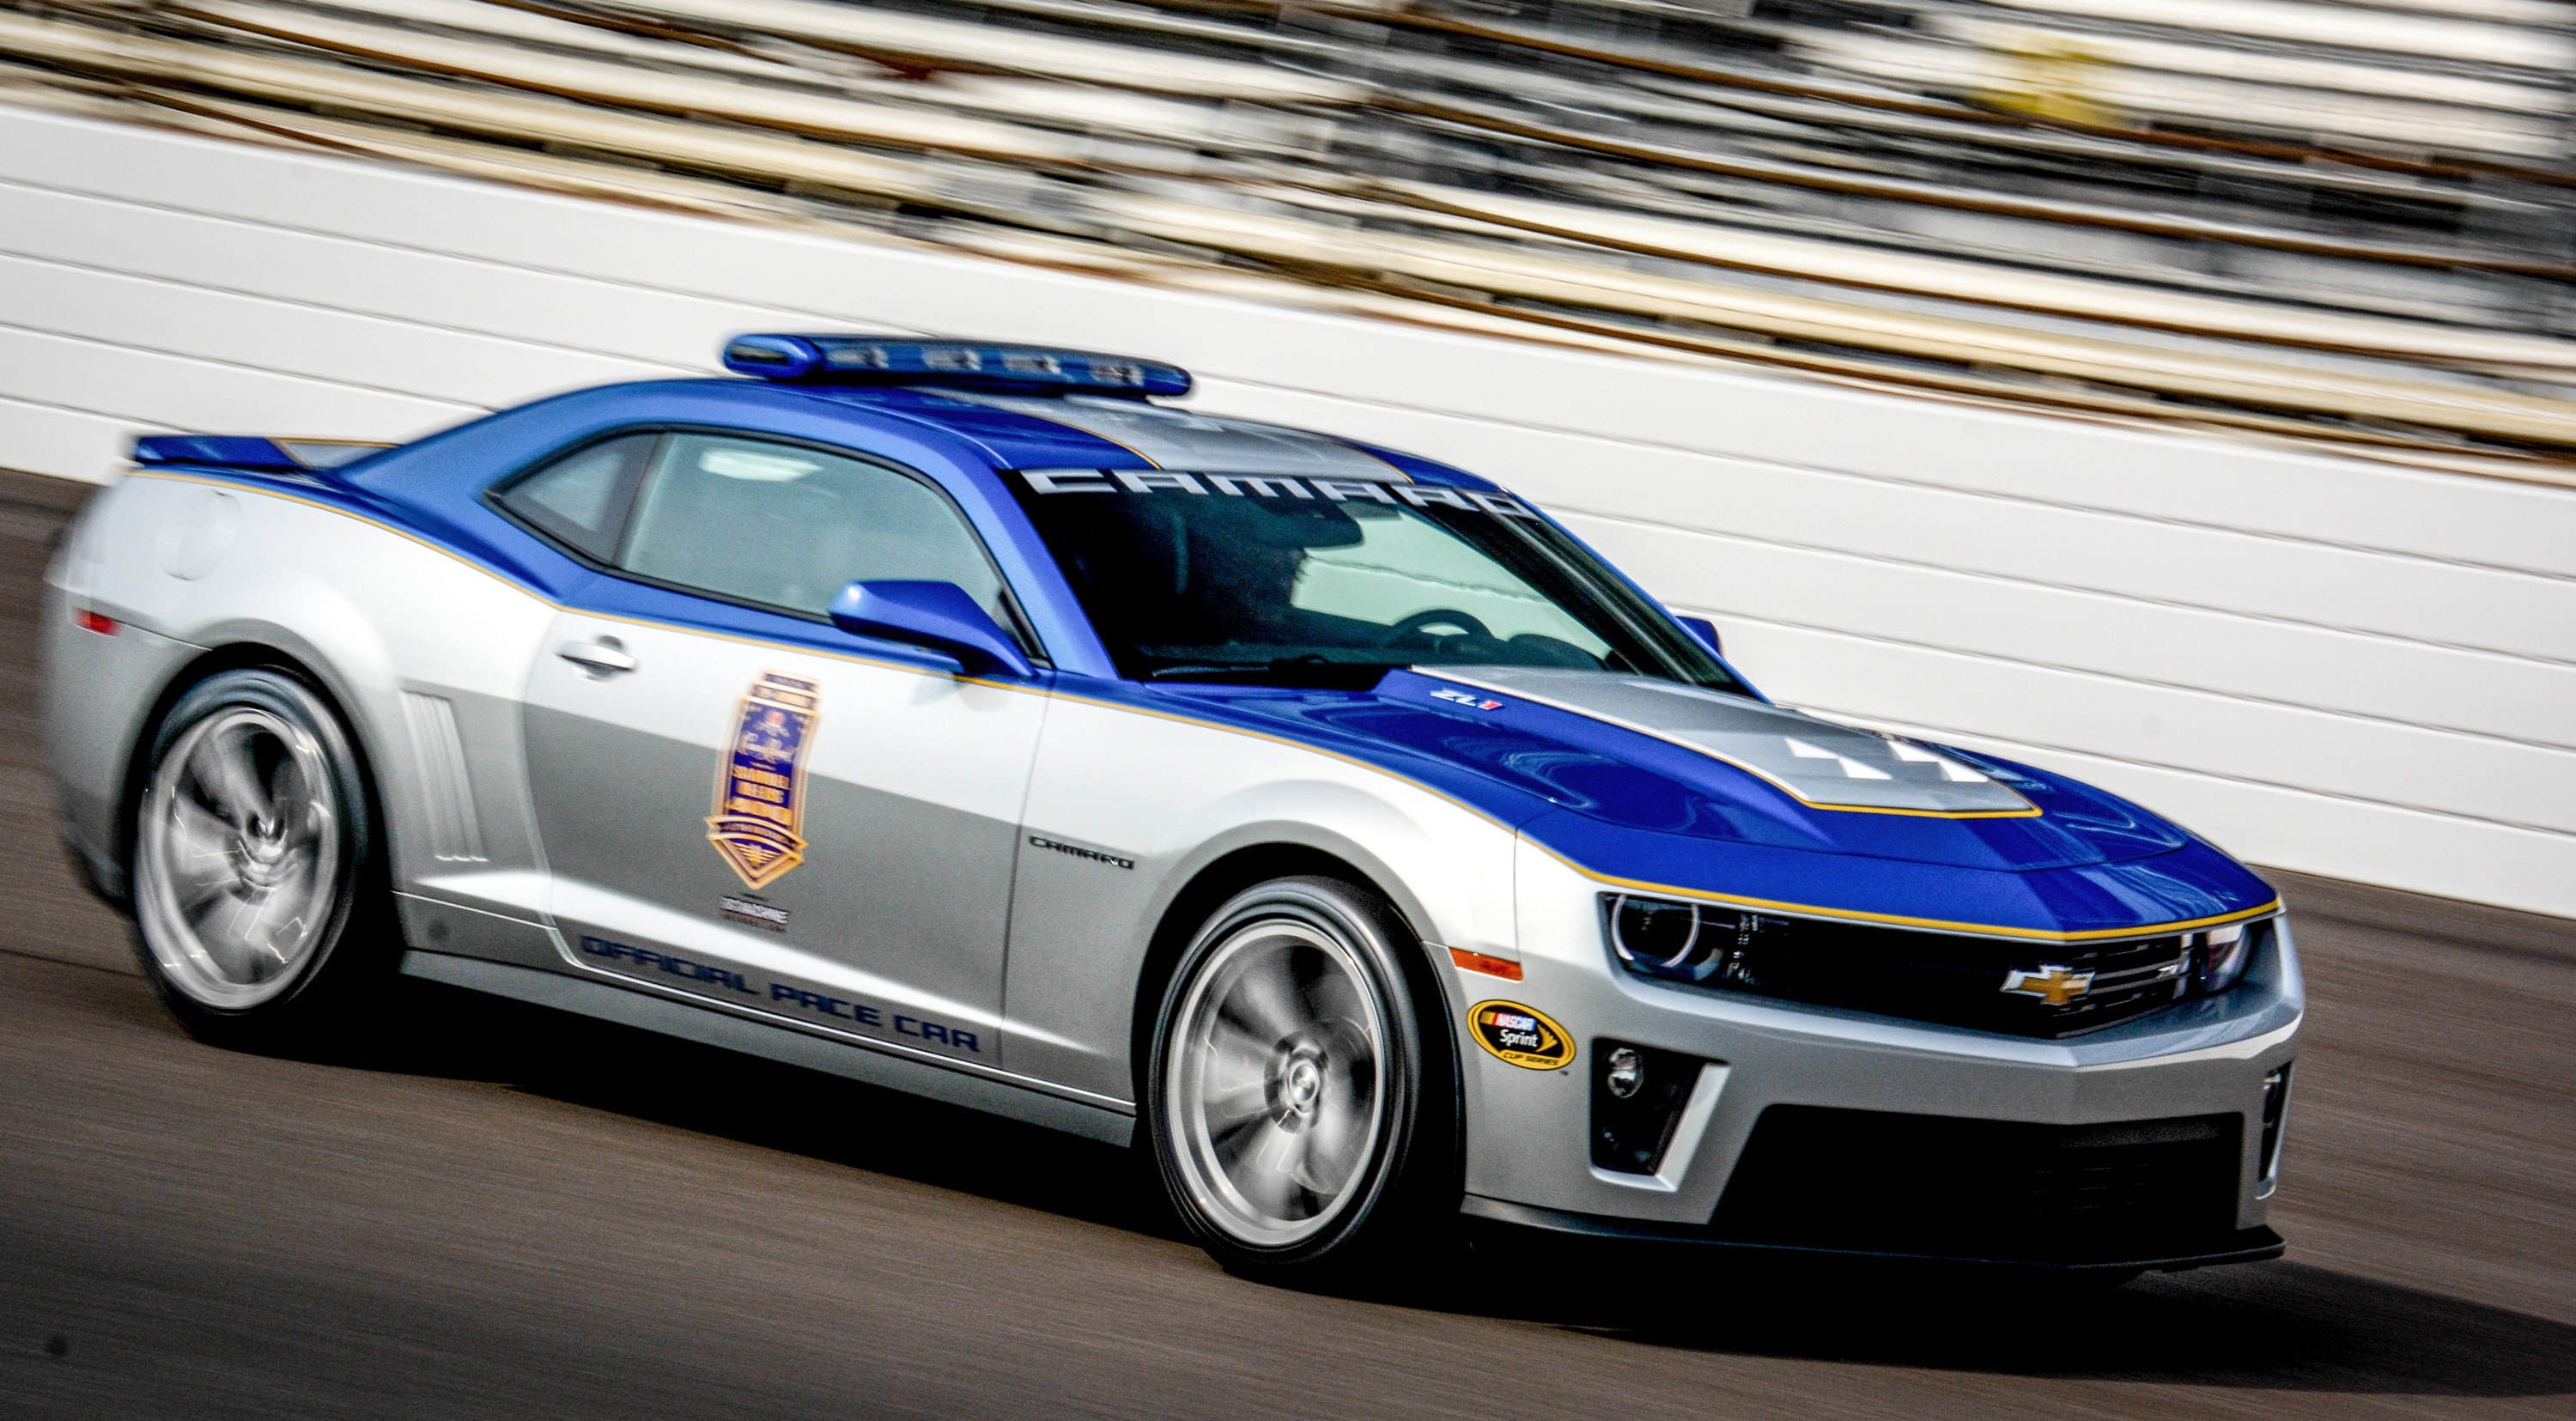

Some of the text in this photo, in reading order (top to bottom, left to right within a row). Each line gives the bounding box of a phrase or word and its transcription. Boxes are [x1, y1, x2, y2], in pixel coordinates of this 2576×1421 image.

[1019, 468, 1542, 521] CAMARO
[1430, 689, 1503, 711] ZL1
[1030, 835, 1134, 870] CAMARO
[581, 935, 981, 1053] OFFICIAL PACE CAR
[1496, 1013, 1537, 1031] NASCAR
[1499, 1029, 1539, 1047] Sprint
[1525, 1055, 1559, 1066] SERIES
